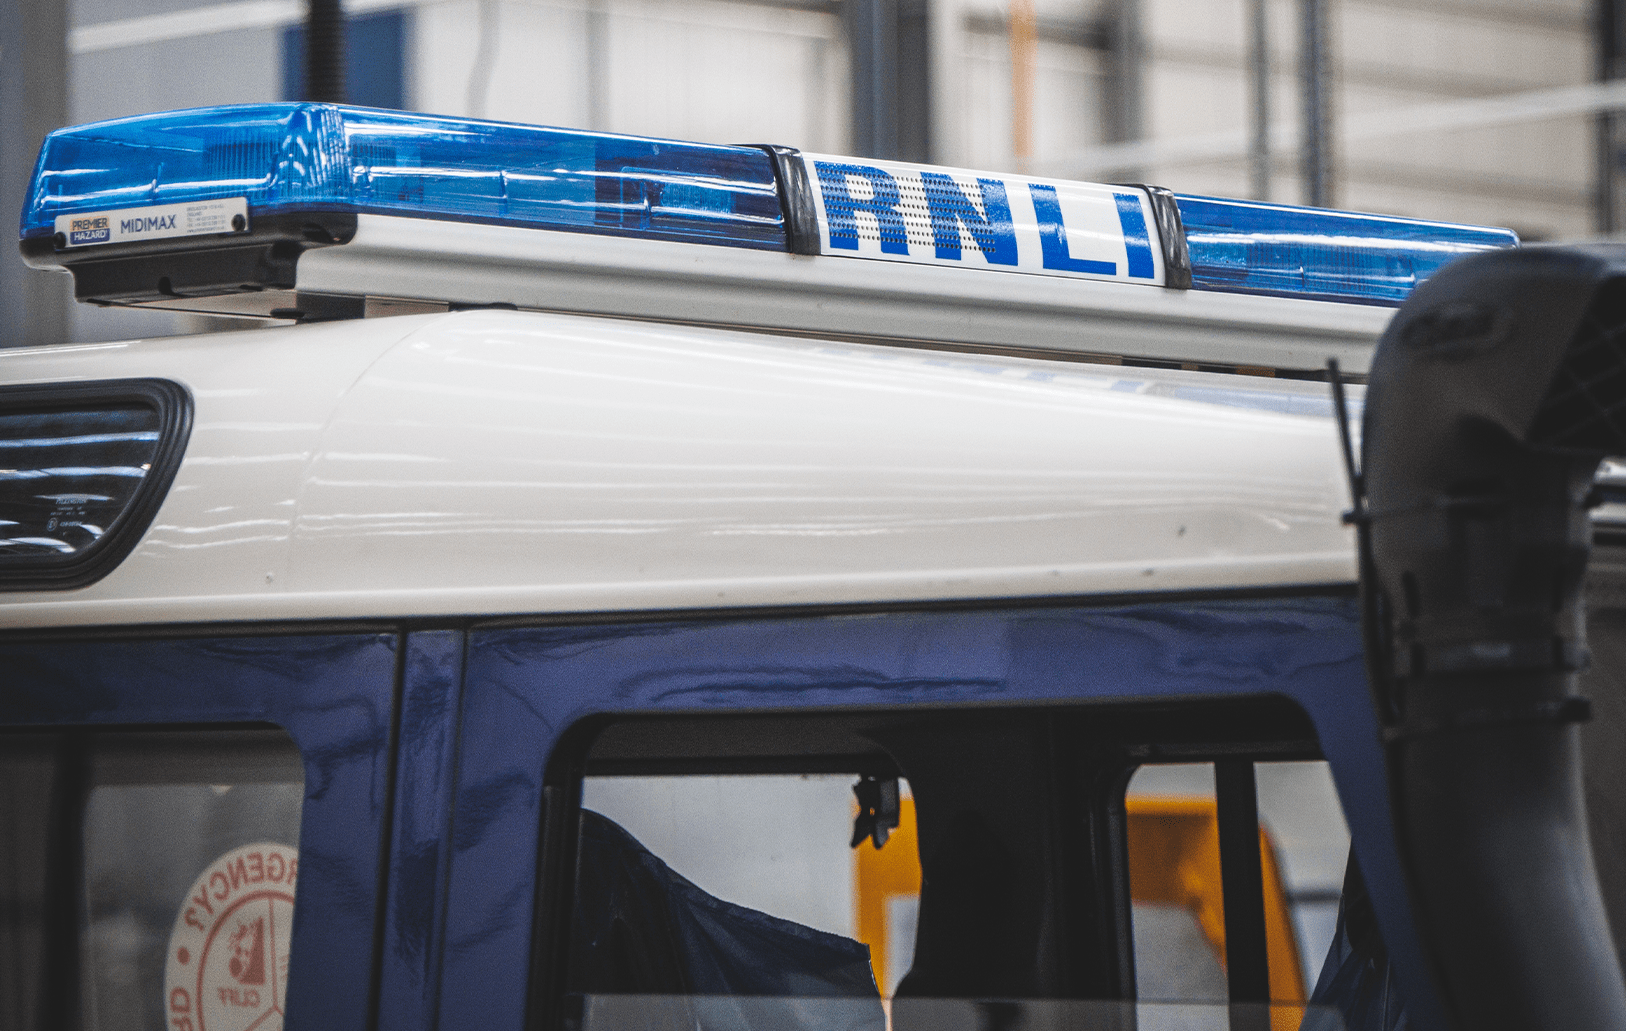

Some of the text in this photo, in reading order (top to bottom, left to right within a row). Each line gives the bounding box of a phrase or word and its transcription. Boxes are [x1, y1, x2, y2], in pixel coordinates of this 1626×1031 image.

[72, 217, 108, 231] PREMIER
[120, 214, 177, 234] MIDIMAX
[813, 160, 1155, 279] RNLI
